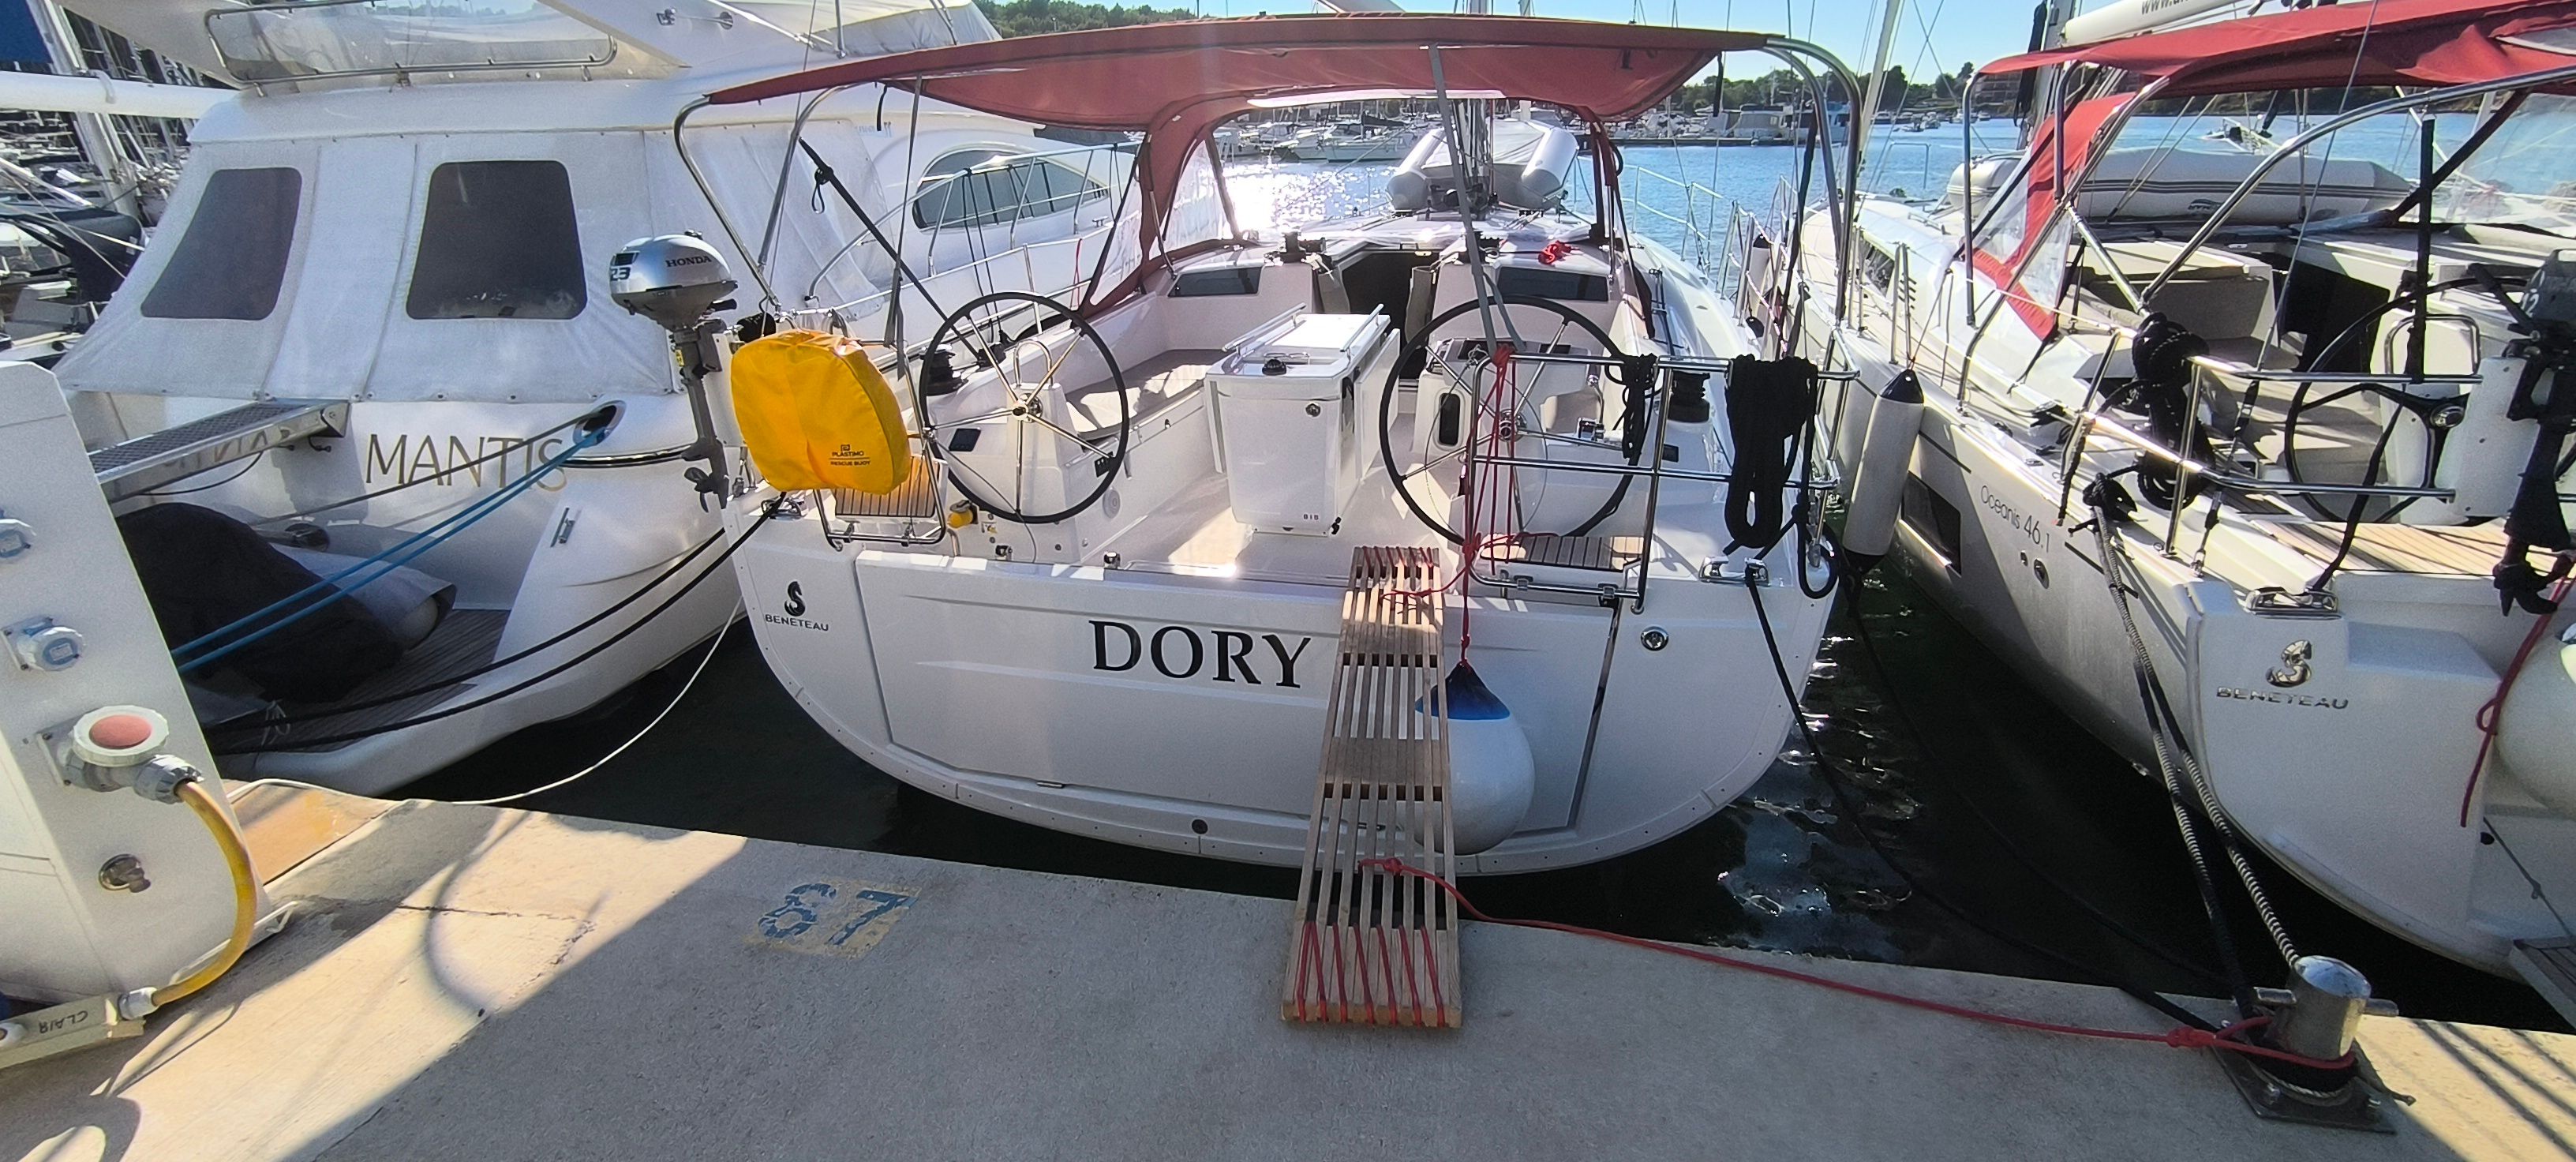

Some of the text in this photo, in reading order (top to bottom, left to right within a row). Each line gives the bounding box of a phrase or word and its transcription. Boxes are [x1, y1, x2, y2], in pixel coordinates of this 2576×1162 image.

[665, 255, 712, 268] HONDA
[365, 433, 567, 492] MANTIS
[1981, 485, 2050, 553] Oceanis 46.1
[765, 614, 829, 632] BENETEAU
[1088, 620, 1312, 688] DORY
[2216, 687, 2349, 709] BENETEAU
[39, 1010, 88, 1034] CLAIR
